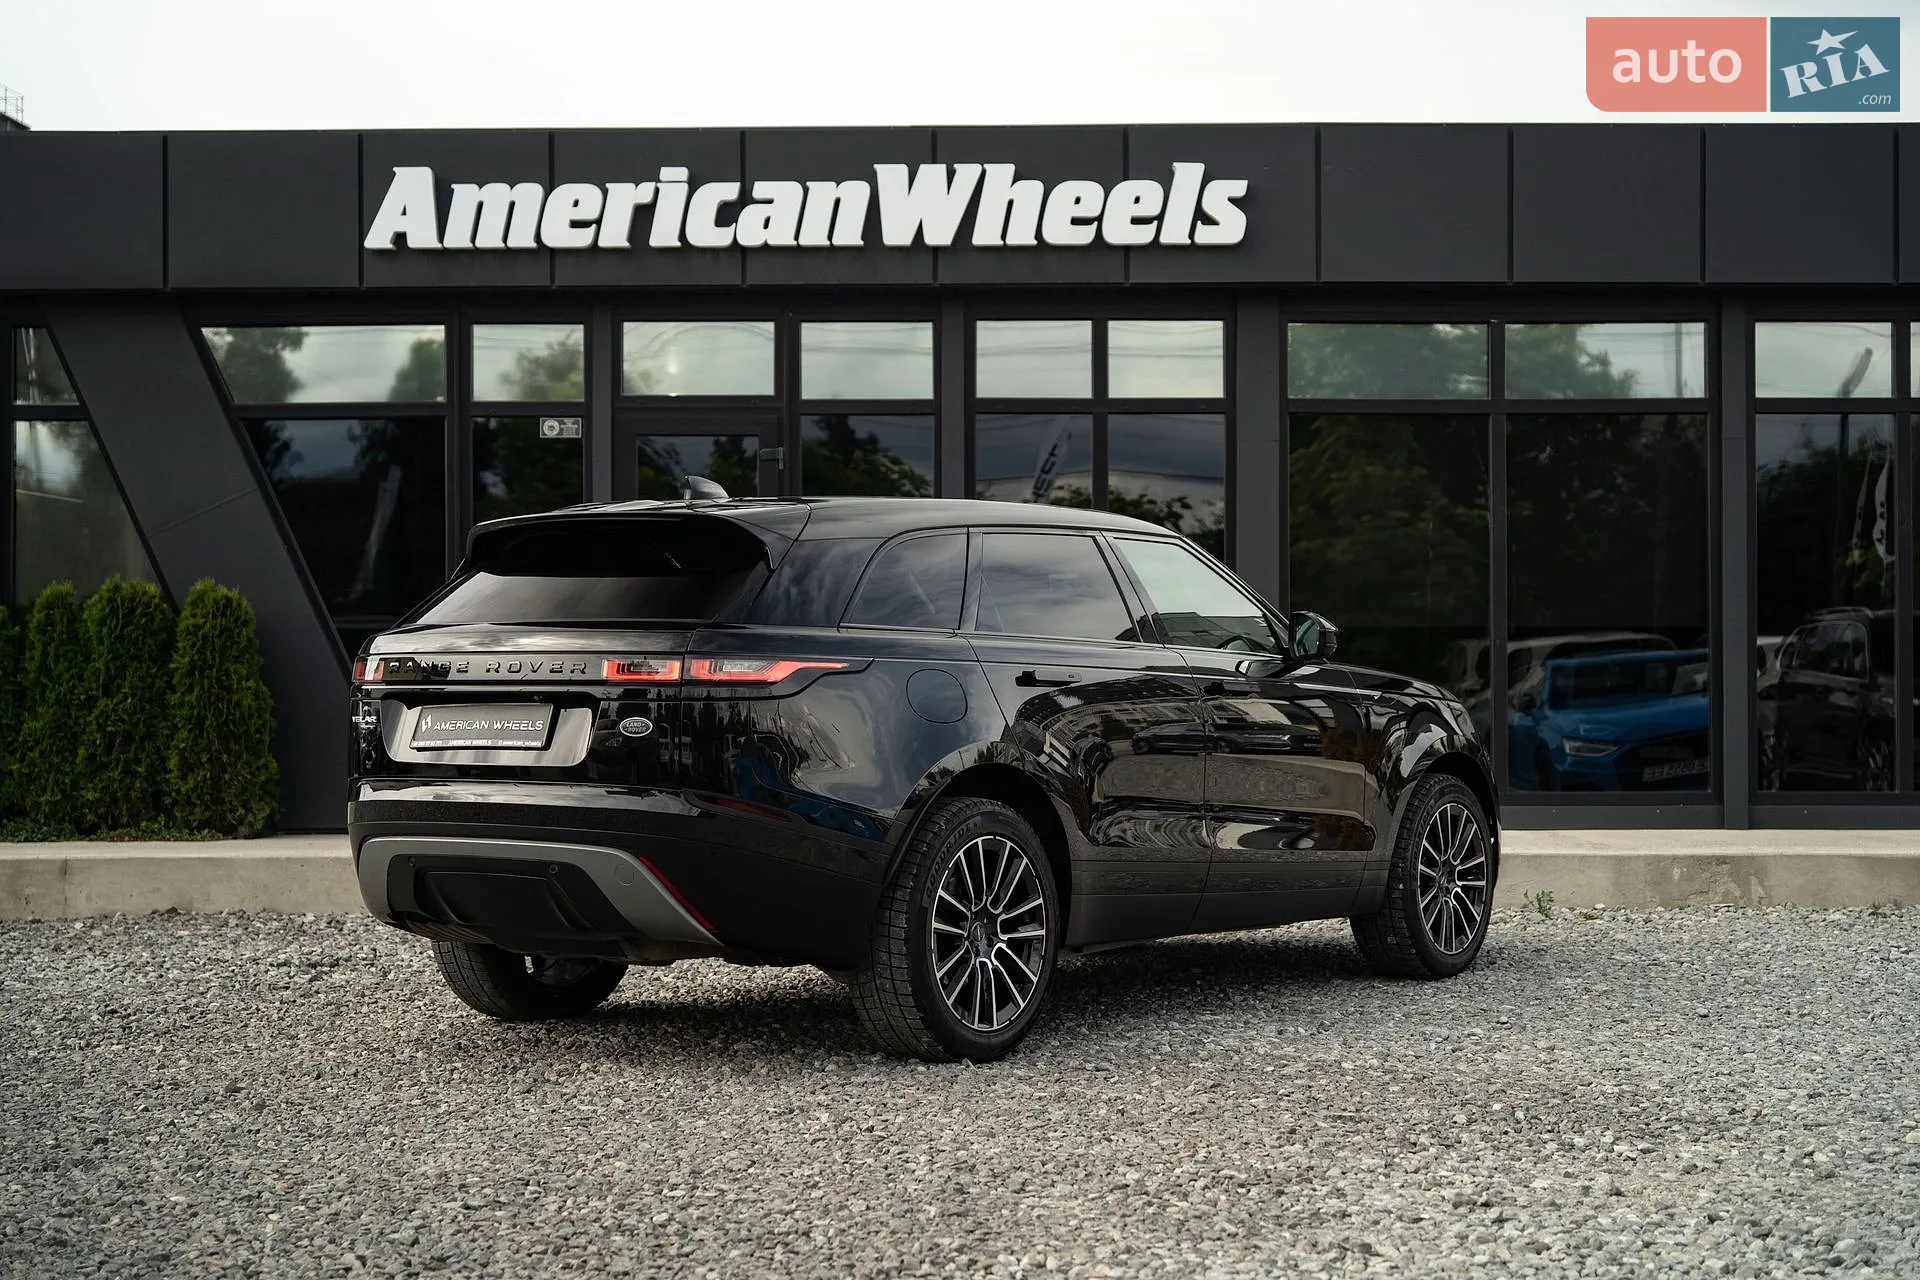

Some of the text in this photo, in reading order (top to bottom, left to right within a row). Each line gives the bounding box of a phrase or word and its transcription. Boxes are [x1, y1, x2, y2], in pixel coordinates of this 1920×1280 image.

[363, 162, 1249, 250] AmericanWheels
[389, 660, 587, 675] RANGE ROVER
[433, 720, 544, 731] AMERICAN WHEELS
